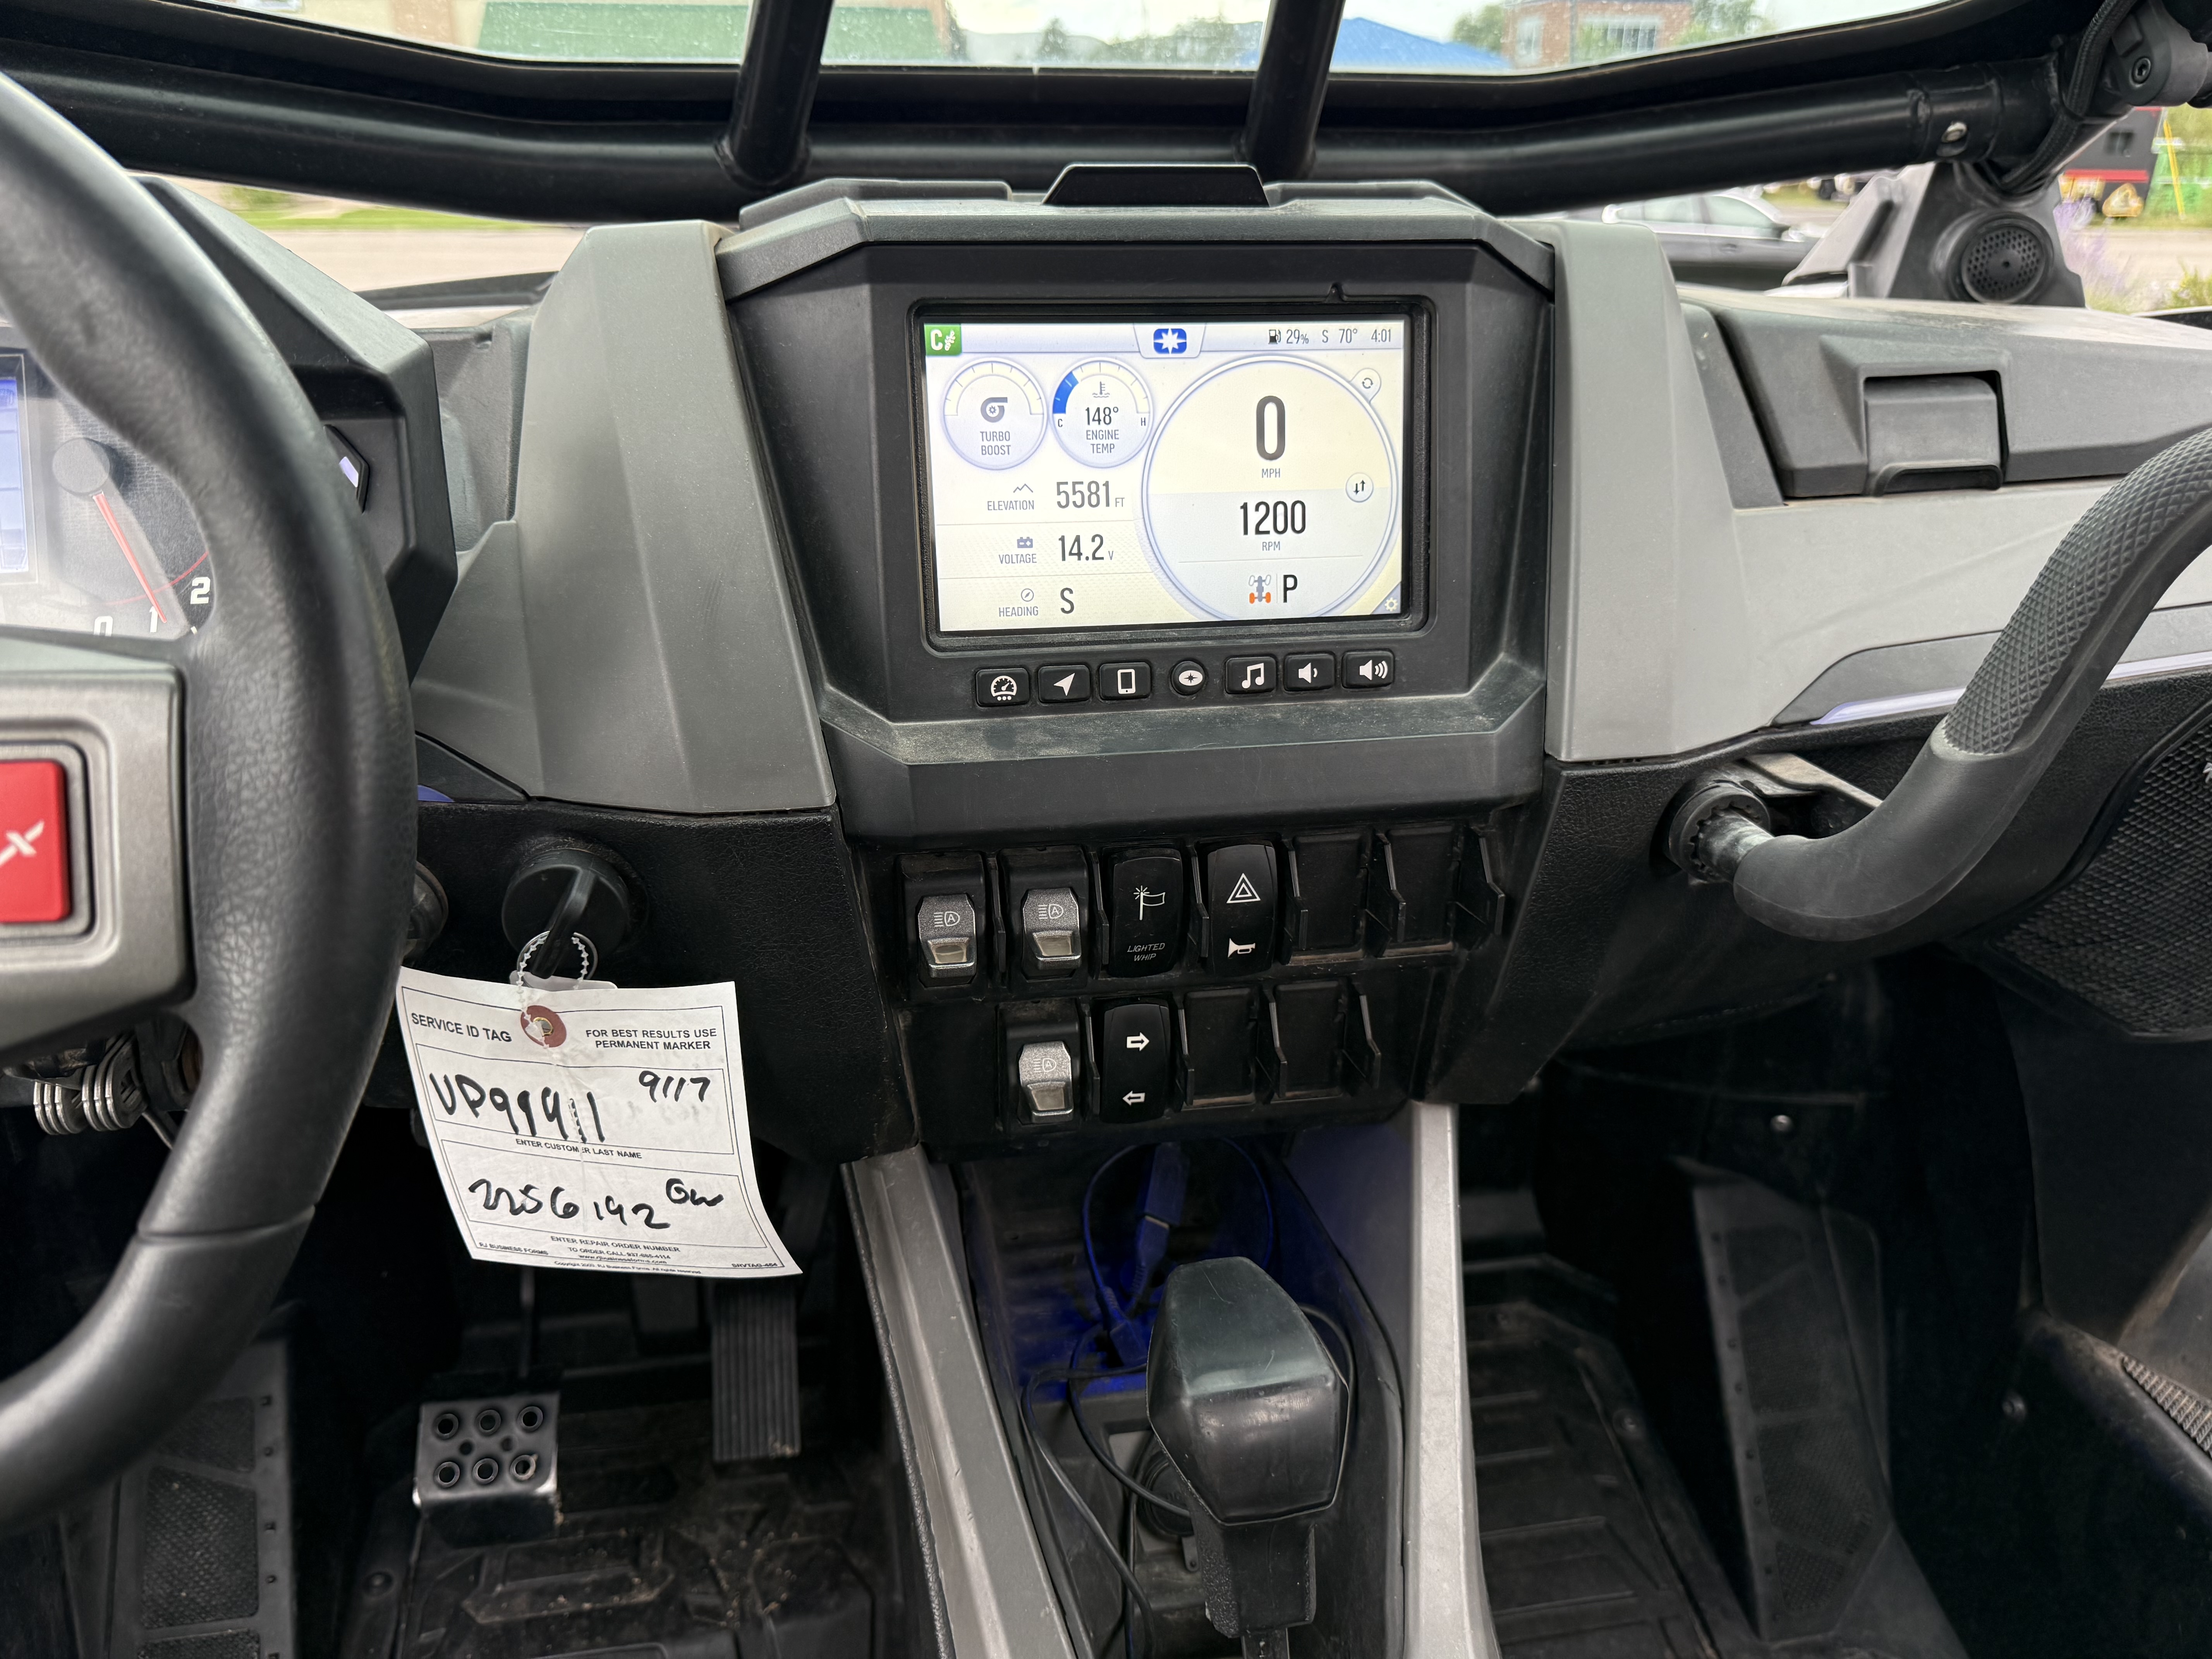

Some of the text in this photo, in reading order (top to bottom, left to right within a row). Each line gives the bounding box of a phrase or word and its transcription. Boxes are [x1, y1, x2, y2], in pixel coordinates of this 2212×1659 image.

[931, 330, 943, 350] C
[1286, 329, 1309, 344] 29%
[1322, 330, 1328, 343] S
[1371, 329, 1392, 342] 4:01
[1058, 419, 1063, 427] C
[1141, 418, 1146, 426] H
[1256, 395, 1285, 460] 0
[980, 431, 1010, 441] TURBO
[1086, 429, 1119, 440] ENGINE
[981, 445, 1011, 455] BOOST
[1091, 443, 1115, 453] TEMP
[1262, 468, 1280, 478] MPH
[1056, 481, 1125, 508] 5581 FT
[987, 500, 1034, 510] ELEVATION
[1240, 500, 1306, 536] 1200
[1058, 534, 1104, 562] 14.2
[1262, 541, 1280, 551] RPM
[999, 553, 1037, 564] VOLTAGE
[190, 577, 211, 605] 2
[1283, 575, 1298, 603] P
[1060, 587, 1075, 614] S
[999, 606, 1039, 617] HEADING
[149, 606, 158, 633] 1
[1127, 943, 1165, 952] LIGHTED
[1134, 953, 1156, 961] WHIP
[411, 1013, 512, 1042] SERVICE ID TAG
[642, 1030, 690, 1038] RESULTS
[694, 1029, 717, 1037] USE
[596, 1041, 711, 1050] PERMANENT MARKER
[515, 1139, 642, 1159] ENTER CUSTOMER LAST NAME
[551, 1236, 578, 1244] ENTER
[489, 1243, 523, 1252] BUSINESS
